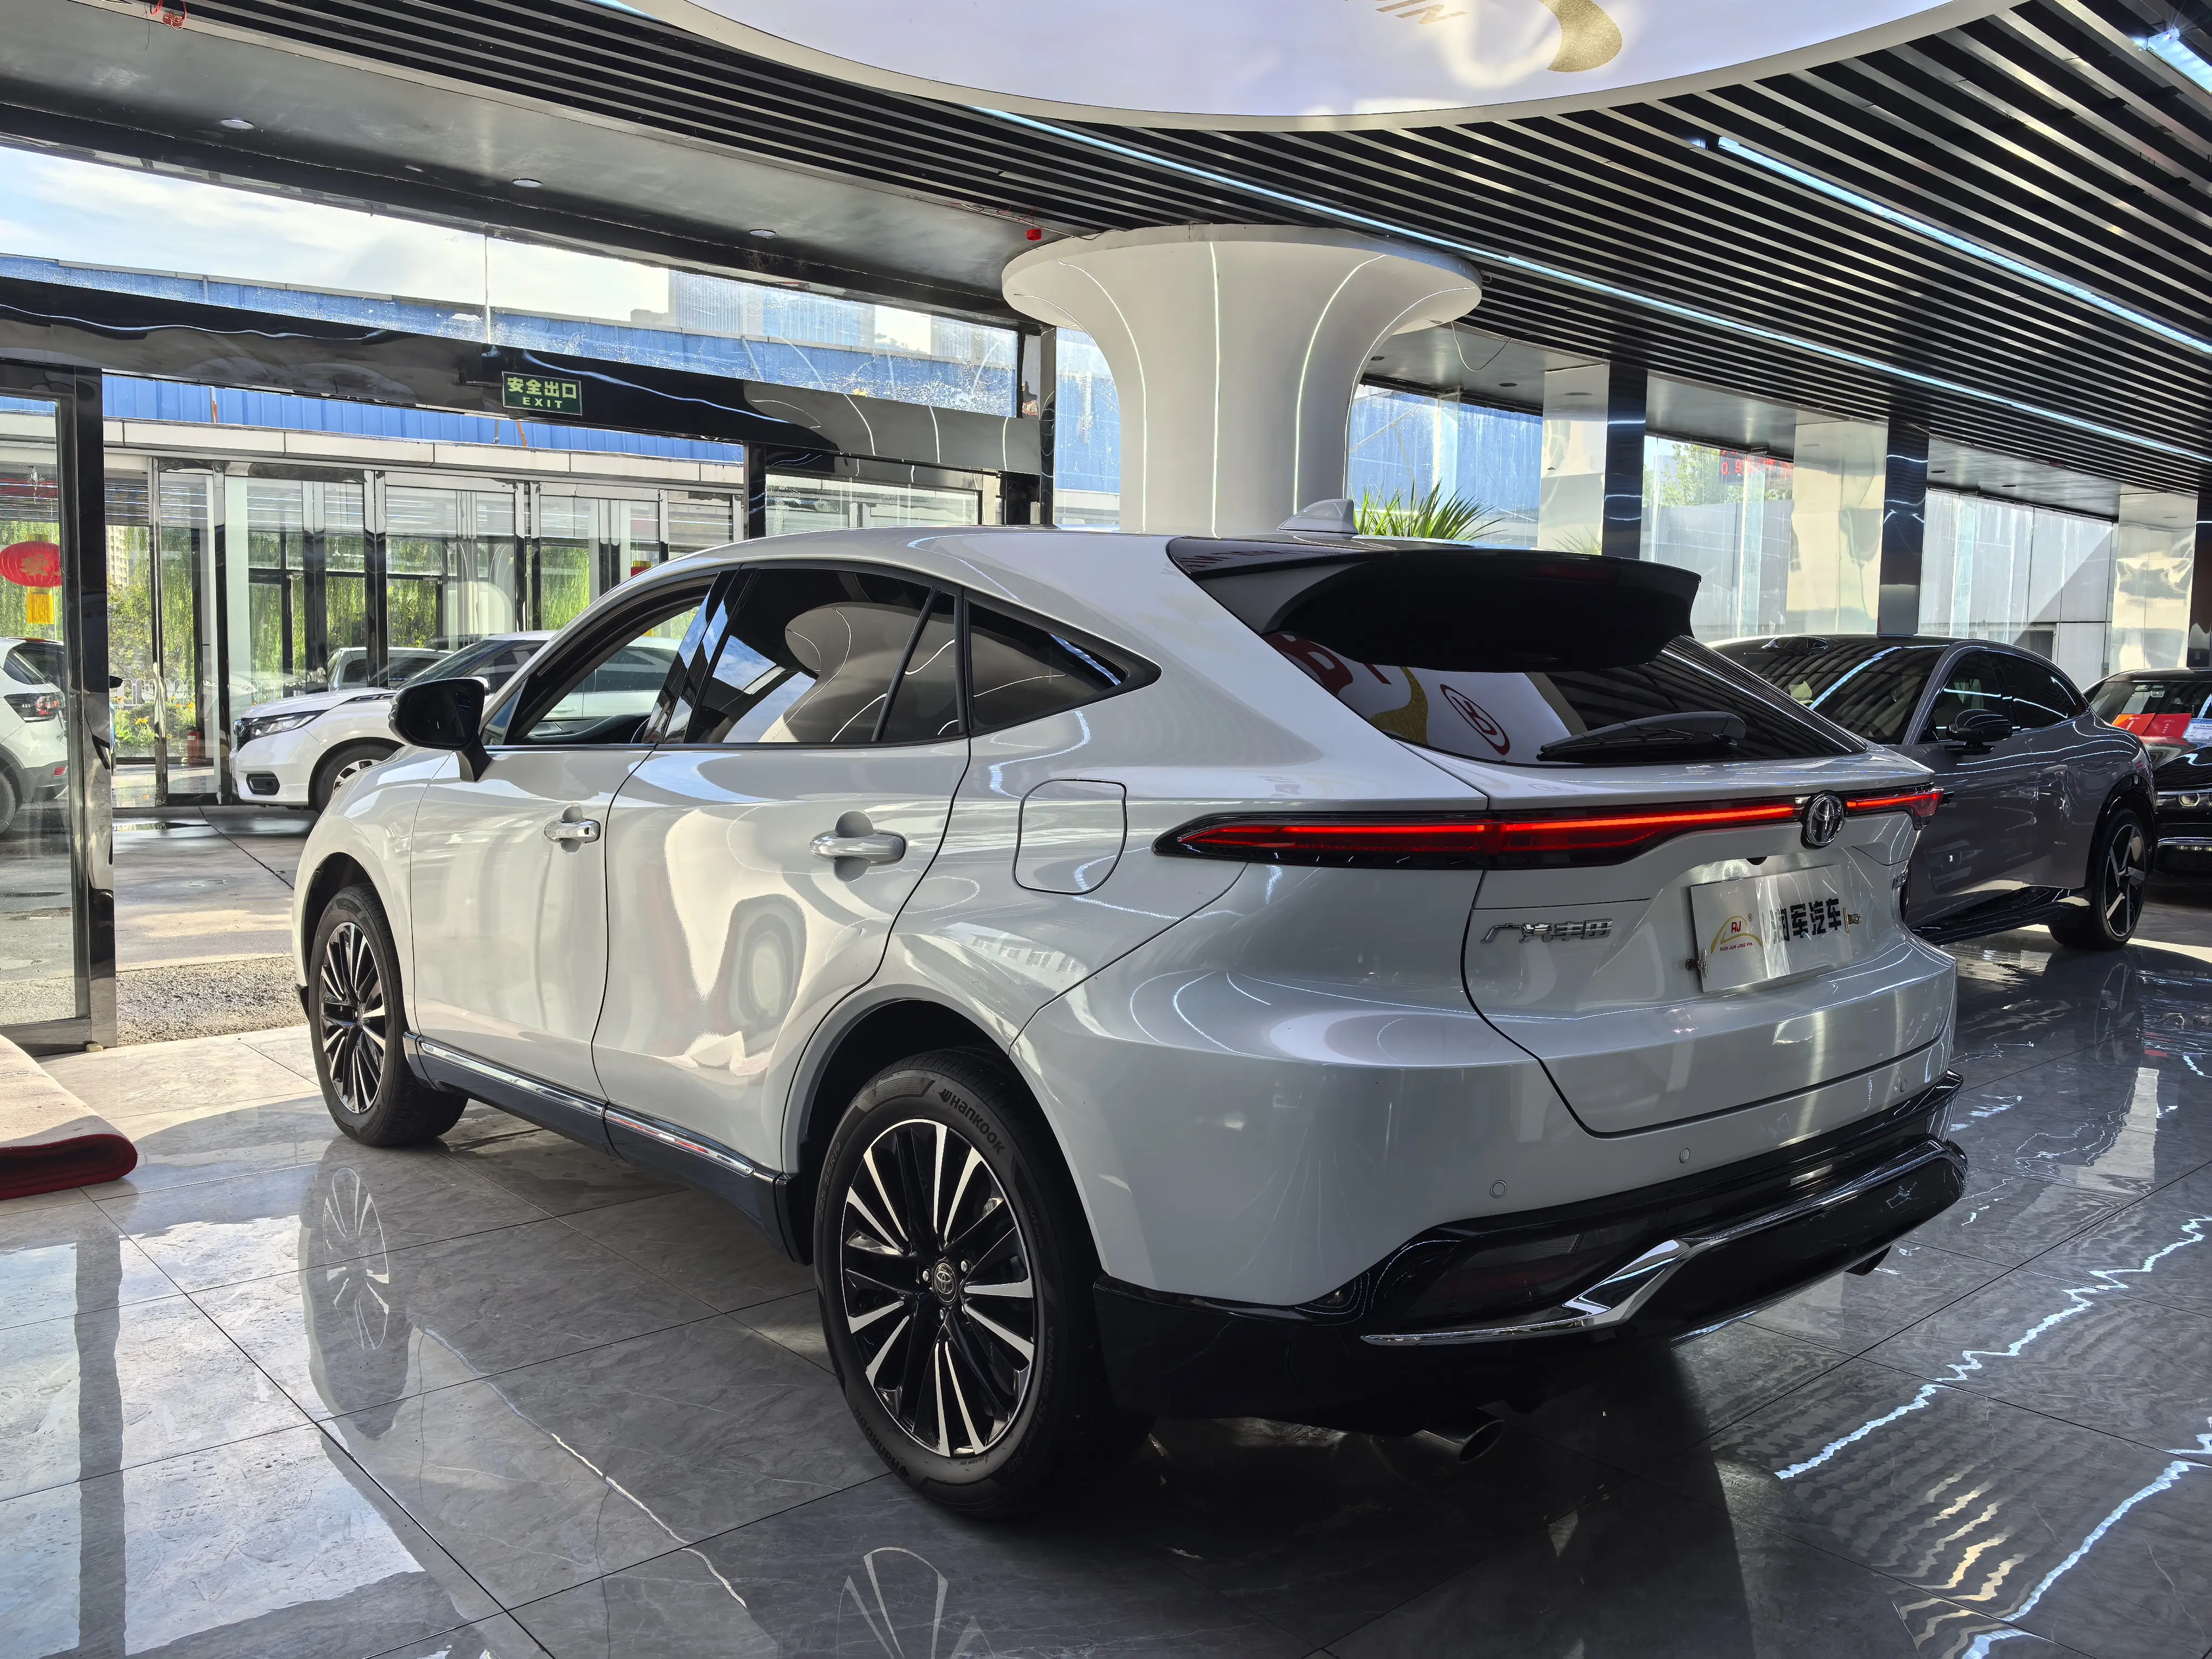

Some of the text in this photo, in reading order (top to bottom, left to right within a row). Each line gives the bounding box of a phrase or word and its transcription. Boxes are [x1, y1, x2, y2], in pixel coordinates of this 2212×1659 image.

[507, 377, 577, 399] 安全出口
[523, 396, 563, 409] EXIT
